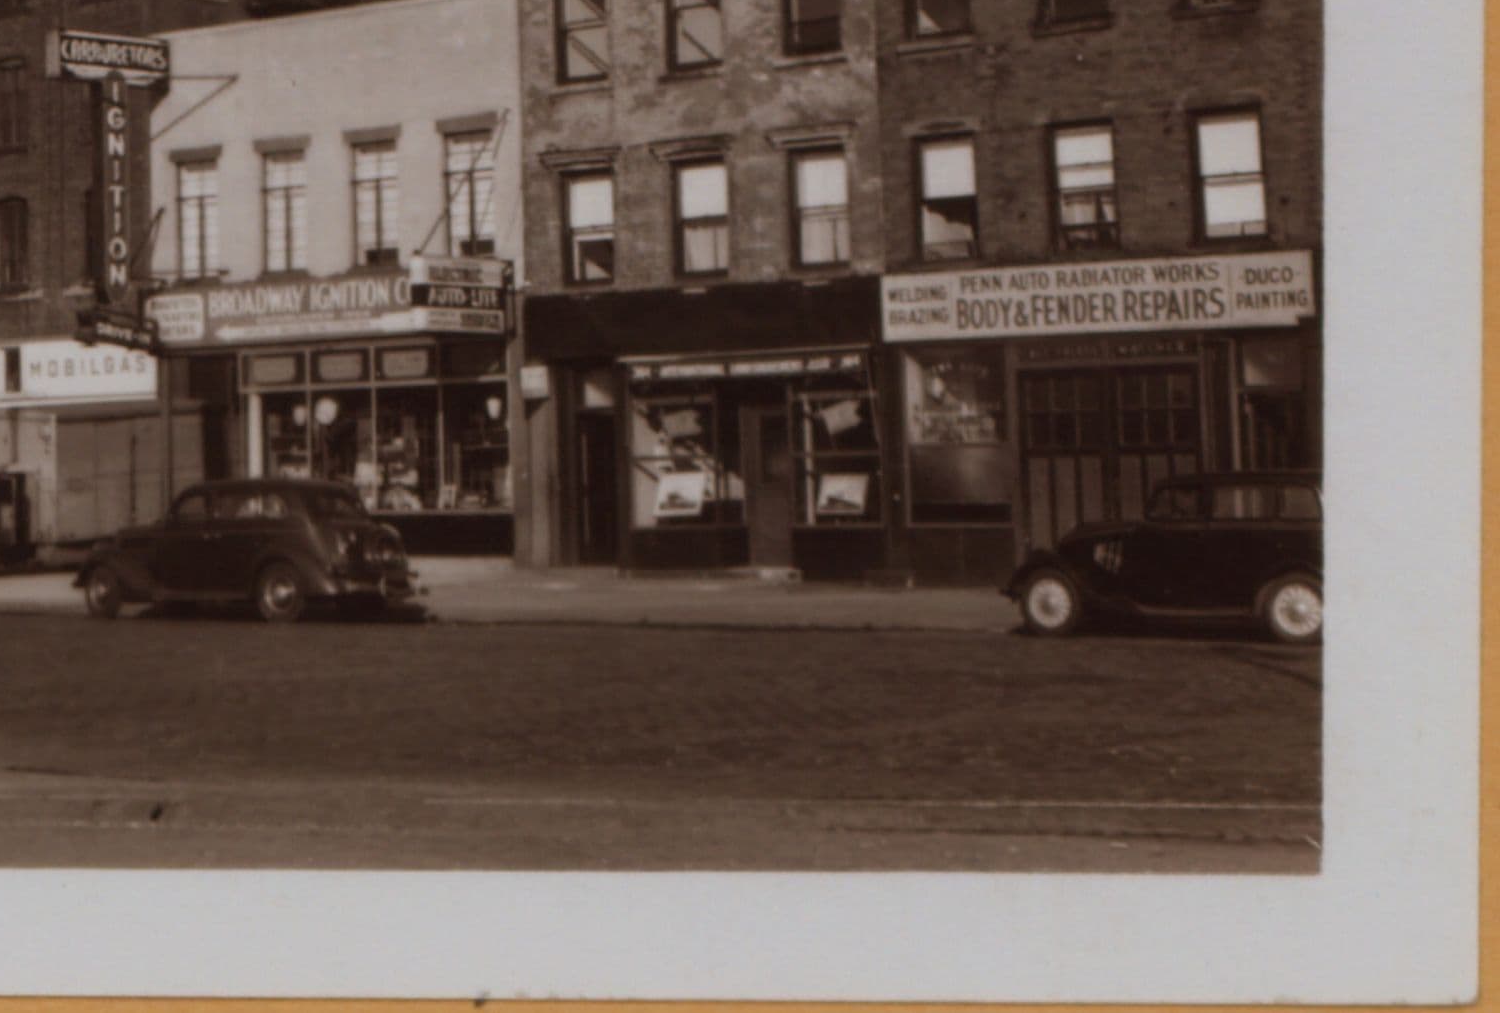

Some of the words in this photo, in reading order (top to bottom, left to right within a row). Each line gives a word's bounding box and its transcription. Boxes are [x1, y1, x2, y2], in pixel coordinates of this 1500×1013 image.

[61, 38, 167, 70] CARBURETORS
[106, 81, 127, 285] IGNITION
[960, 274, 1001, 294] PENN
[1008, 271, 1049, 292] AUTO
[1055, 264, 1147, 288] RADIATOR
[1152, 261, 1220, 283] WORKS
[1244, 265, 1294, 284] DUCO
[208, 283, 309, 319] BROADWAY
[309, 277, 390, 312] IGNITION
[888, 285, 947, 303] WELDING
[1122, 286, 1226, 323] REPAIRS
[1236, 288, 1309, 310] PAINTING
[888, 306, 949, 326] BRAZING
[29, 355, 147, 379] MOBILGAS
